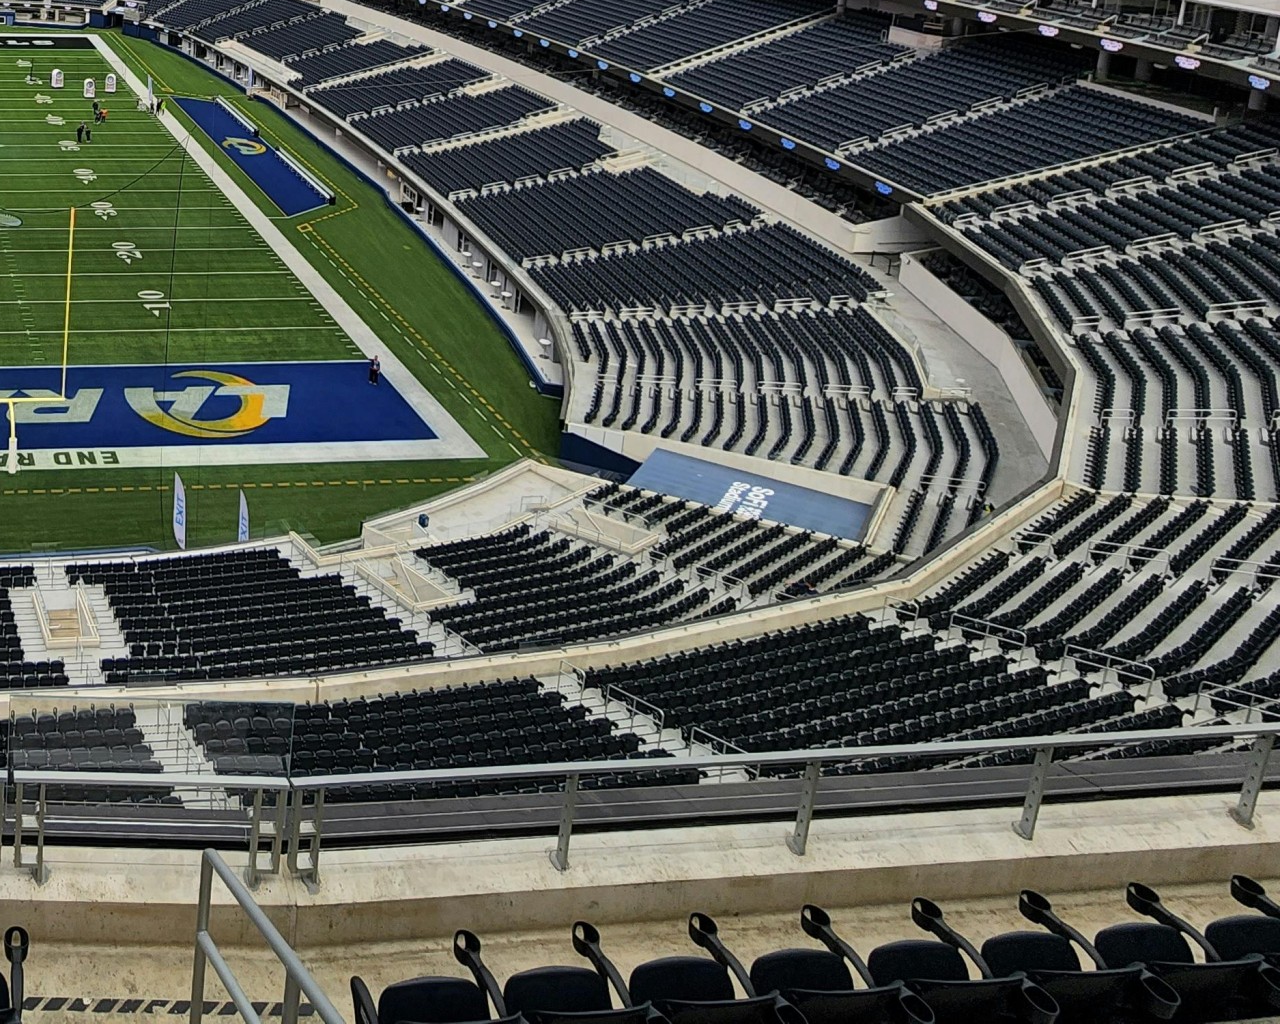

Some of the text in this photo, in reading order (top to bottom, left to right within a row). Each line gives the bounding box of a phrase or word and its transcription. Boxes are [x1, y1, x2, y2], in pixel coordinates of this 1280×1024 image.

[90, 201, 118, 216] 30
[112, 242, 143, 259] 20
[137, 290, 172, 309] 10
[53, 451, 120, 466] END
[175, 493, 184, 527] EXIT
